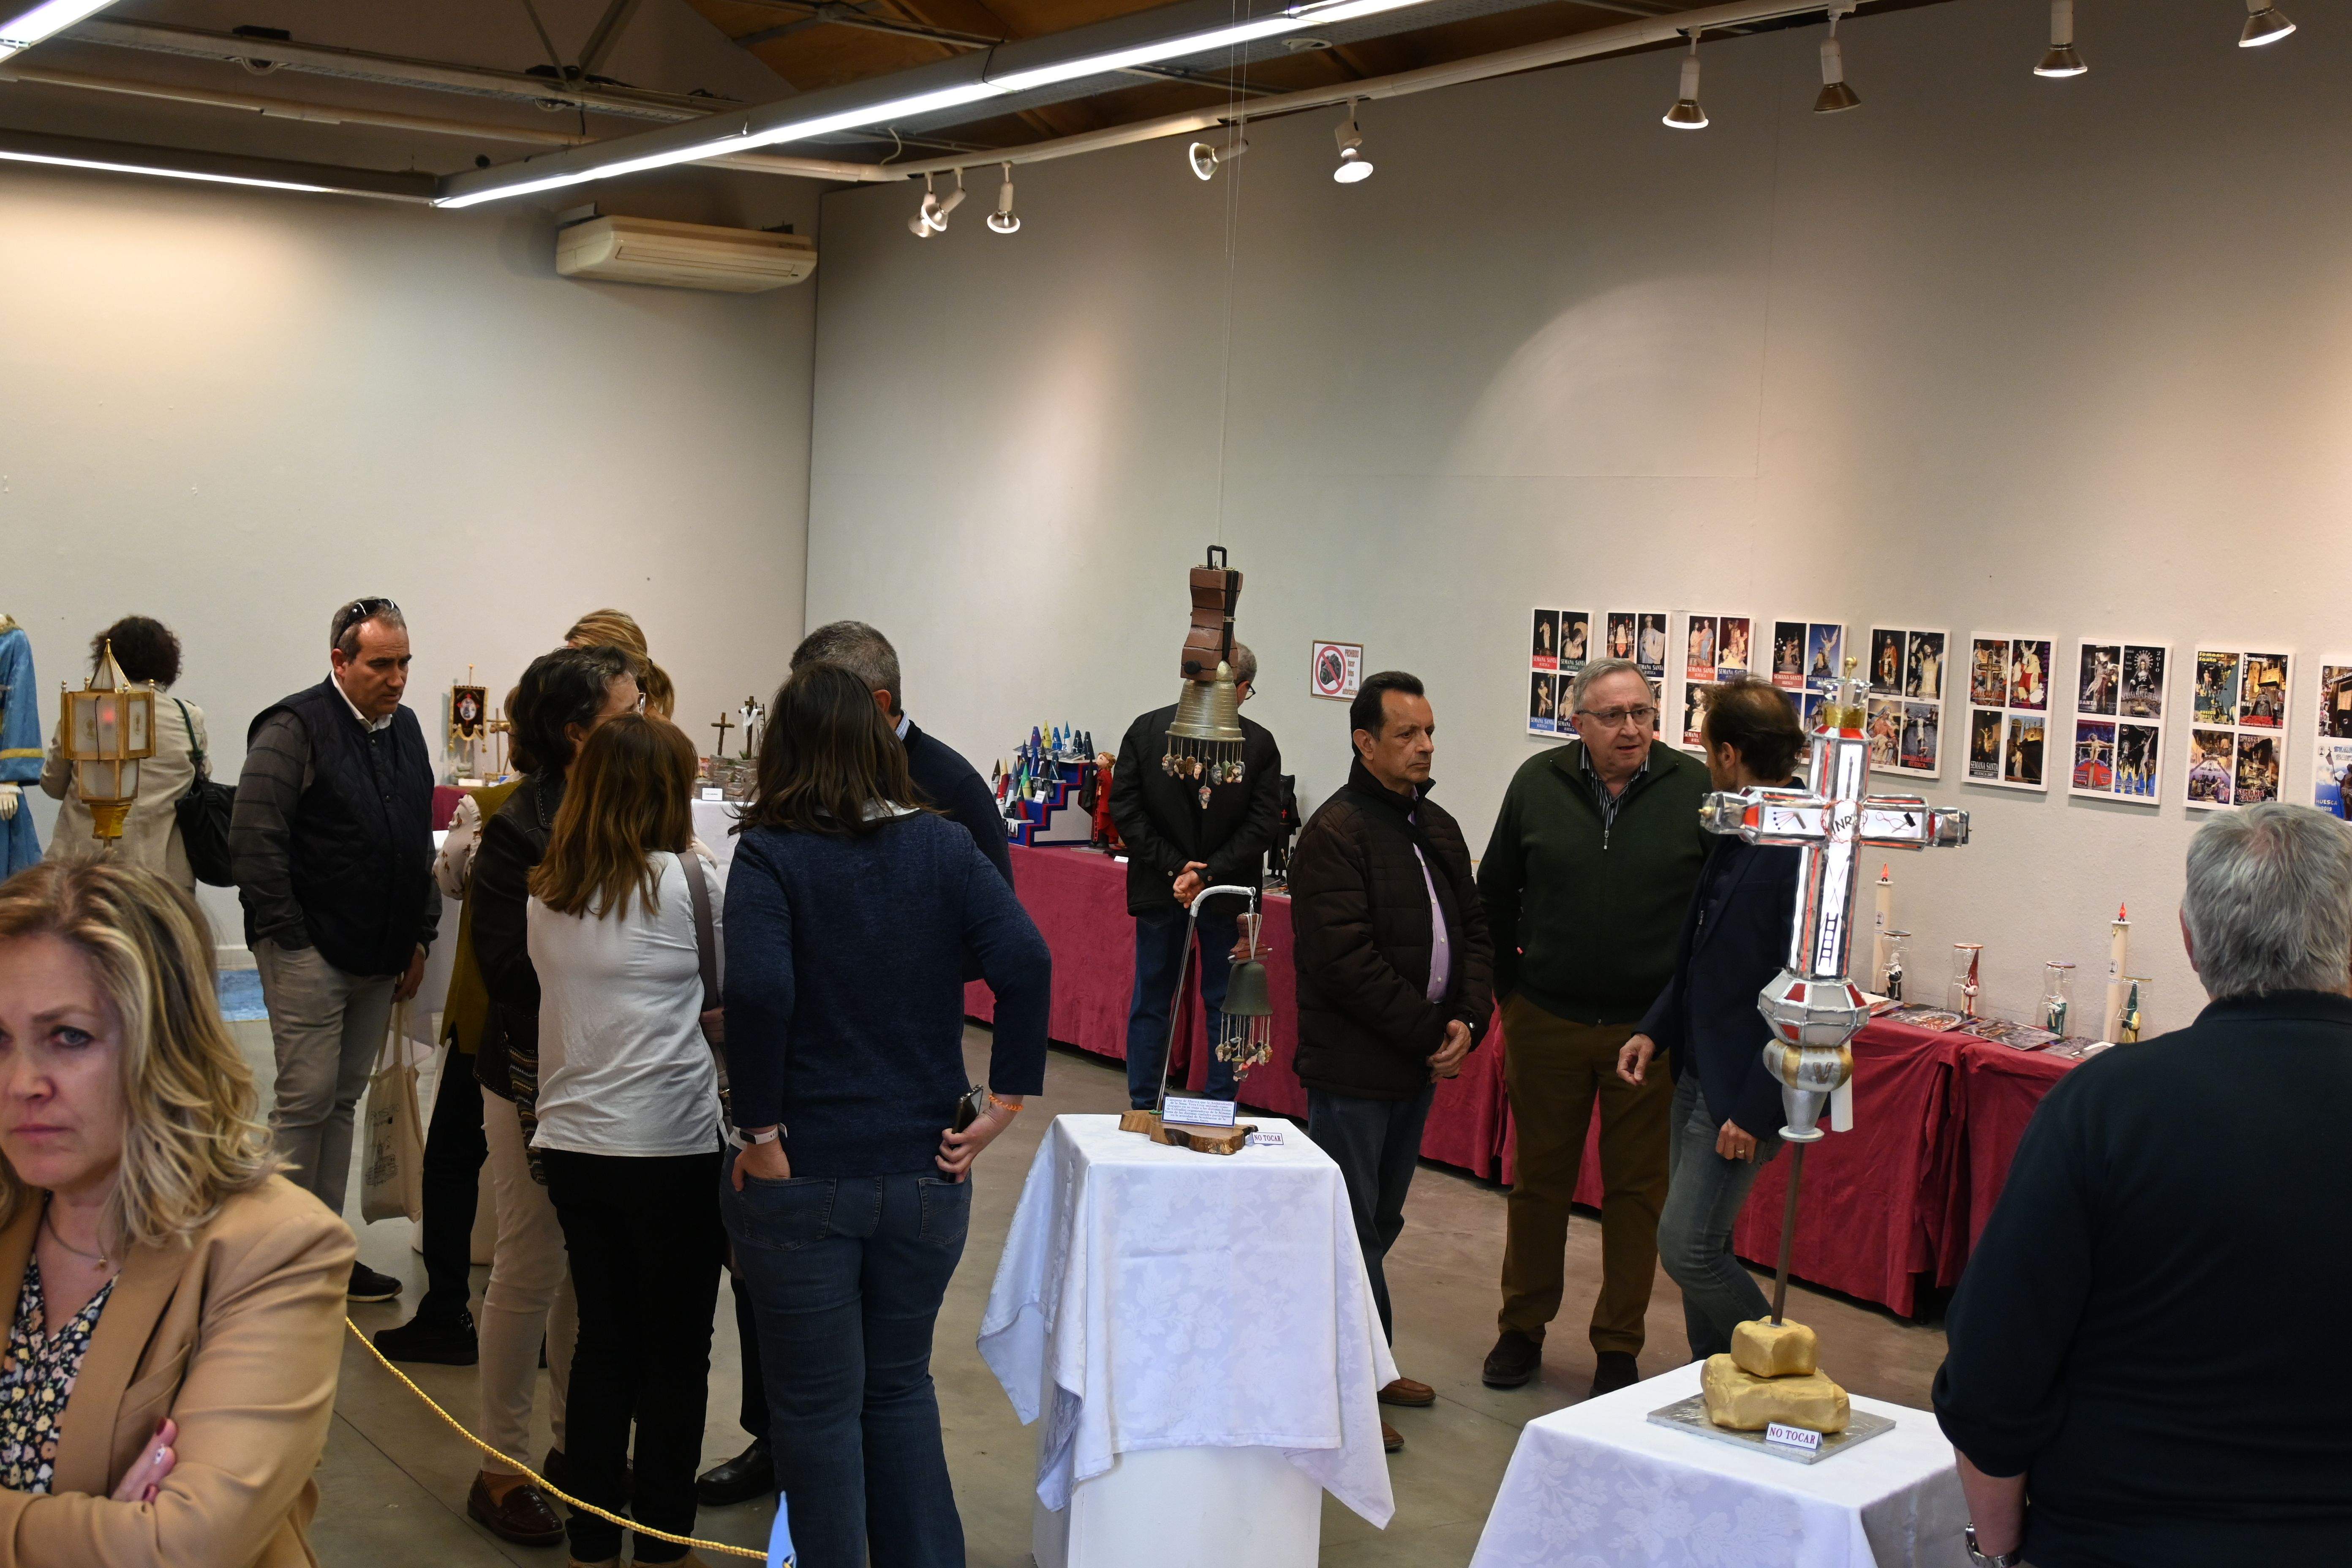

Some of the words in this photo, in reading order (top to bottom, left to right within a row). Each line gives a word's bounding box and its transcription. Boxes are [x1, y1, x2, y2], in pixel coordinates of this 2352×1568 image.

[1970, 760, 1985, 770] SEMANA
[1986, 762, 1998, 772] SANTA
[2238, 788, 2264, 796] SEMANA
[1769, 1427, 1782, 1437] NO
[1786, 1430, 1816, 1444] TOCAR
